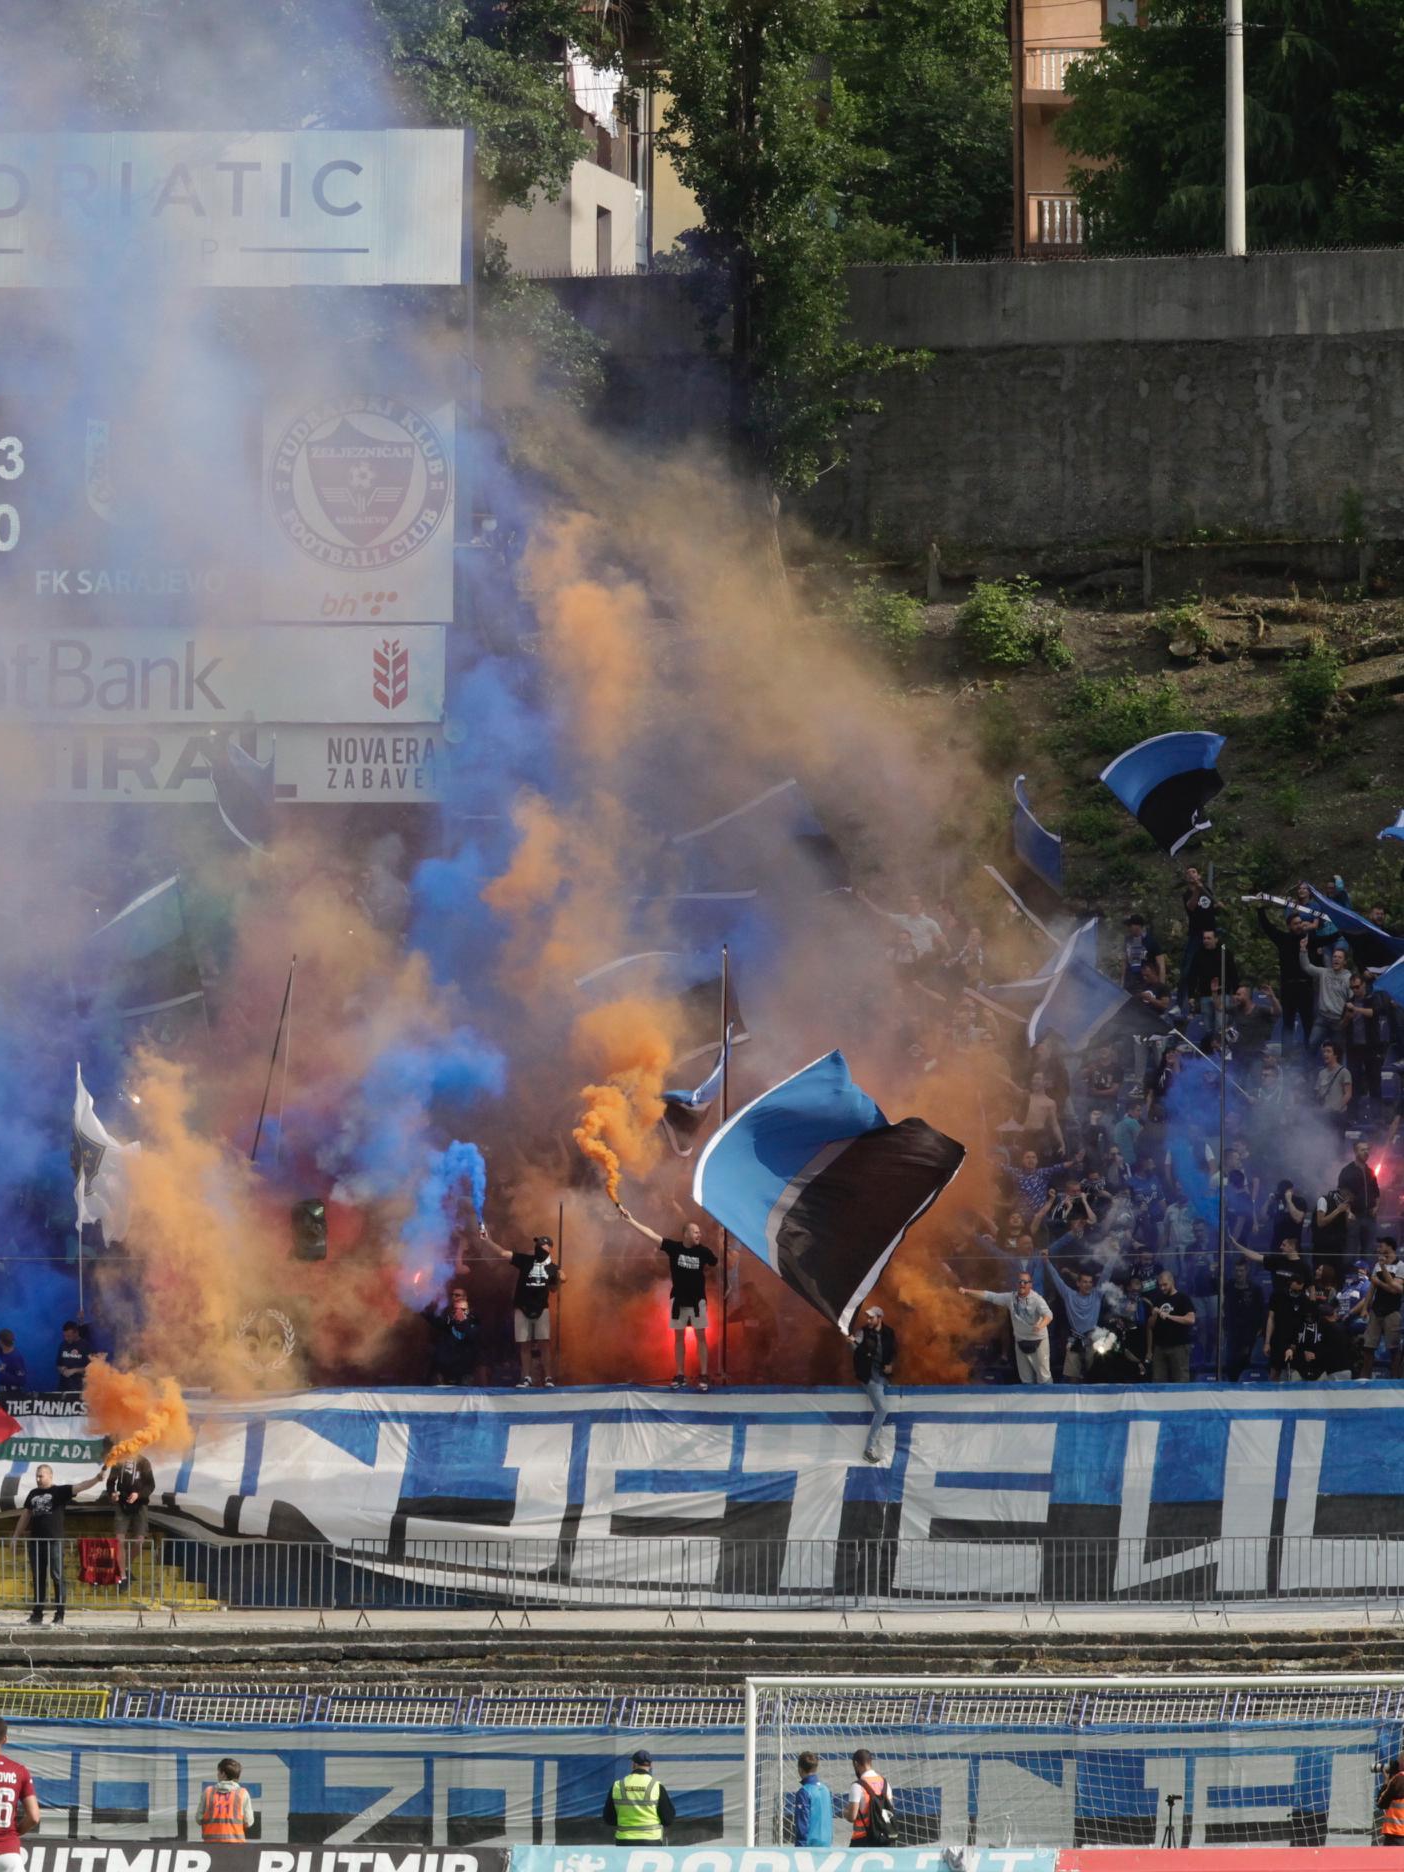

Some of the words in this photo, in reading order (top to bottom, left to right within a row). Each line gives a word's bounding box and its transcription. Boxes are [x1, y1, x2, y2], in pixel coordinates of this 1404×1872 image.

[281, 508, 388, 567] FOOTBALL
[388, 507, 438, 558] CLUB
[35, 571, 71, 595] FK
[326, 736, 388, 764] NOVA
[391, 737, 436, 765] ERA
[6, 1399, 32, 1416] THE
[33, 1398, 88, 1416] MANIACS
[10, 1442, 92, 1460] INTIFADA
